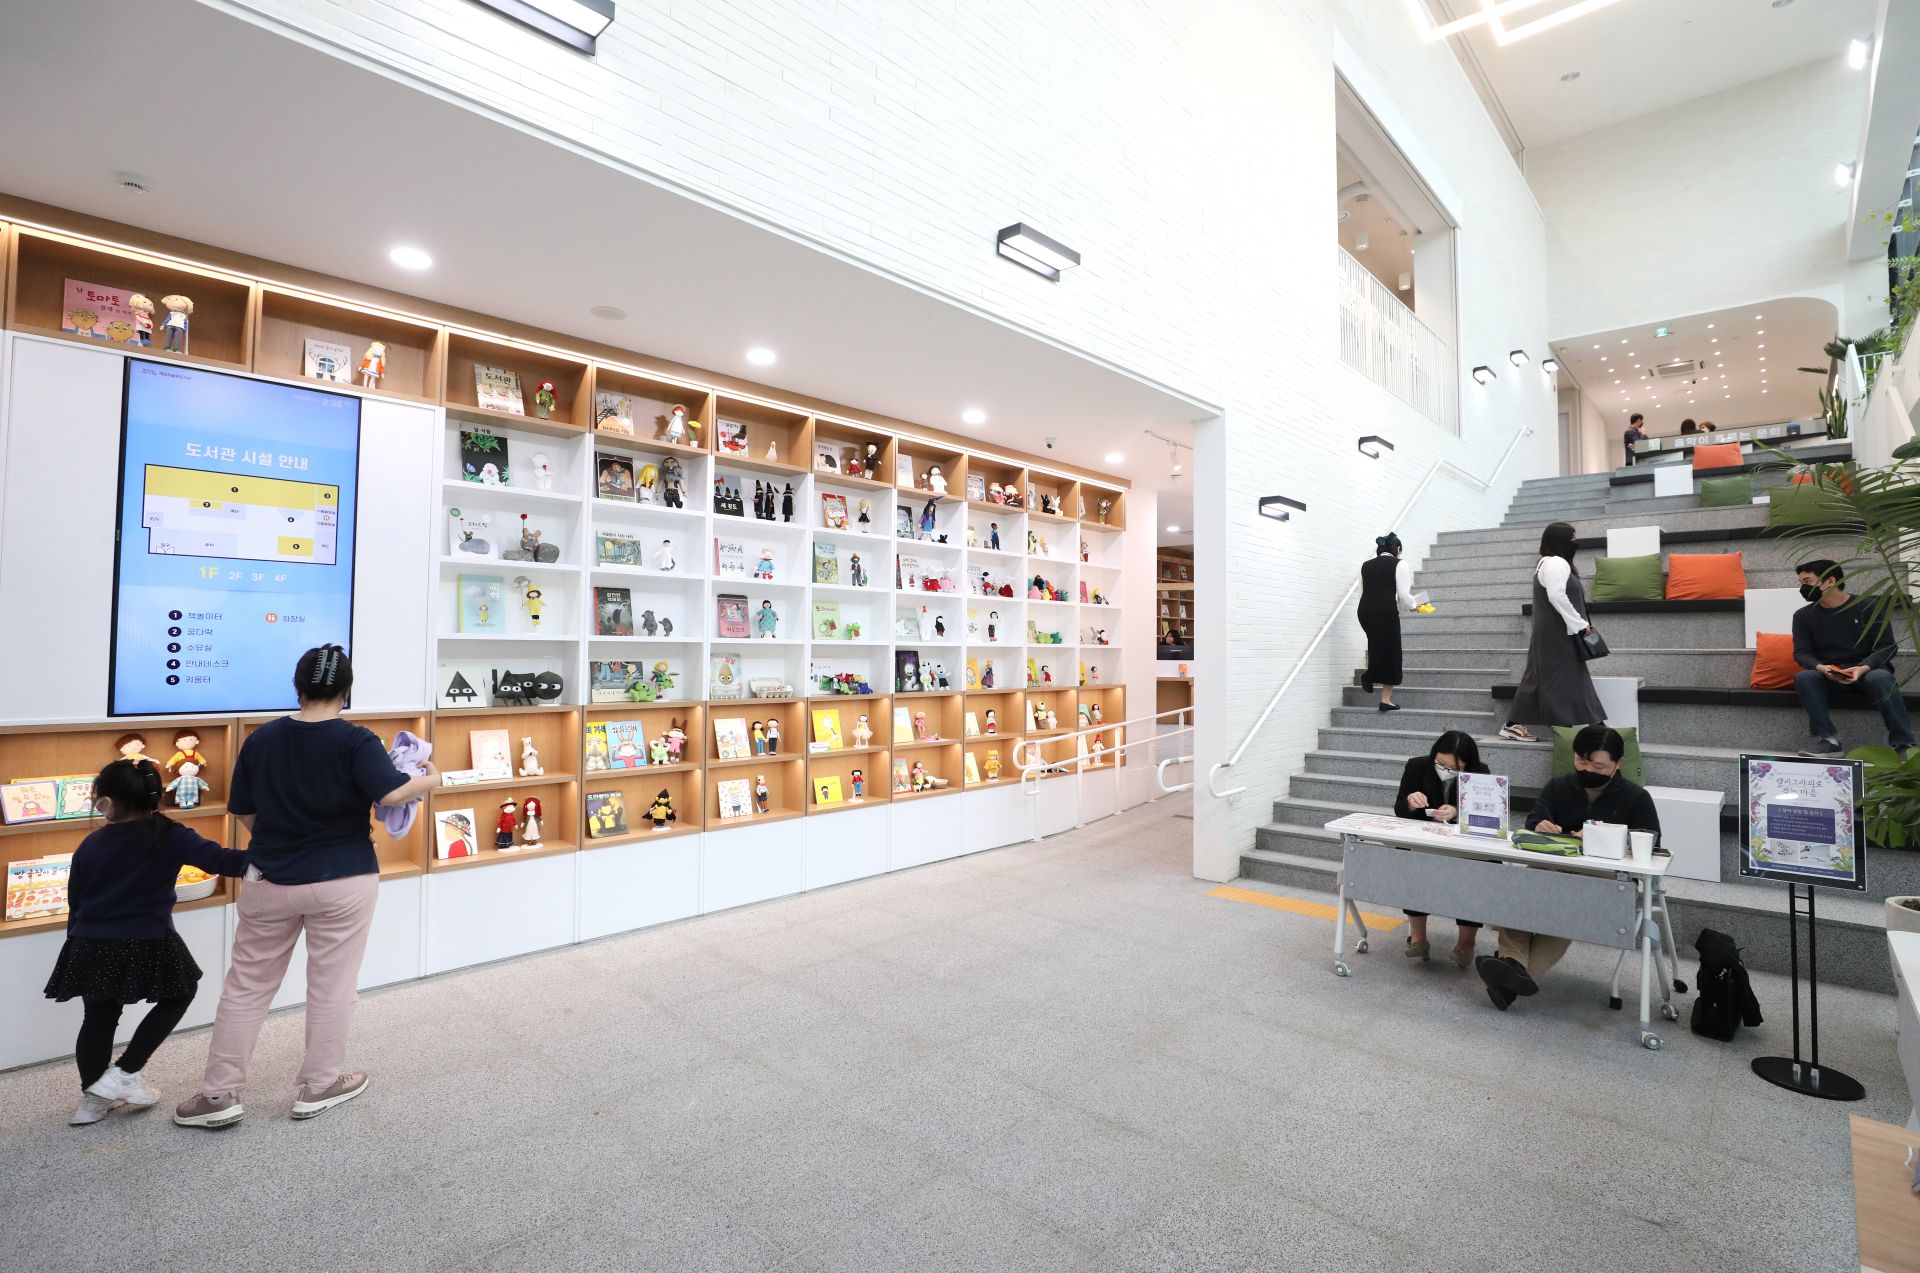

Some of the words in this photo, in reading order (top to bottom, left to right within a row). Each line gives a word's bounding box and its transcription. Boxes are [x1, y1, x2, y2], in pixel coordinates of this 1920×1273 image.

[86, 290, 120, 307] 토마토
[1675, 436, 1708, 448] 음악이
[186, 442, 236, 462] 도서관
[241, 451, 273, 466] 시설
[279, 455, 308, 471] 안내
[199, 566, 219, 579] 1F
[229, 572, 243, 580] 2F
[252, 573, 264, 581] 3F
[274, 574, 287, 582] 4F
[188, 612, 222, 621] 책놀이터
[282, 615, 305, 623] 화장실
[185, 660, 229, 668] 안내데스크
[185, 676, 211, 684] 키움터
[1800, 787, 1816, 798] 마음
